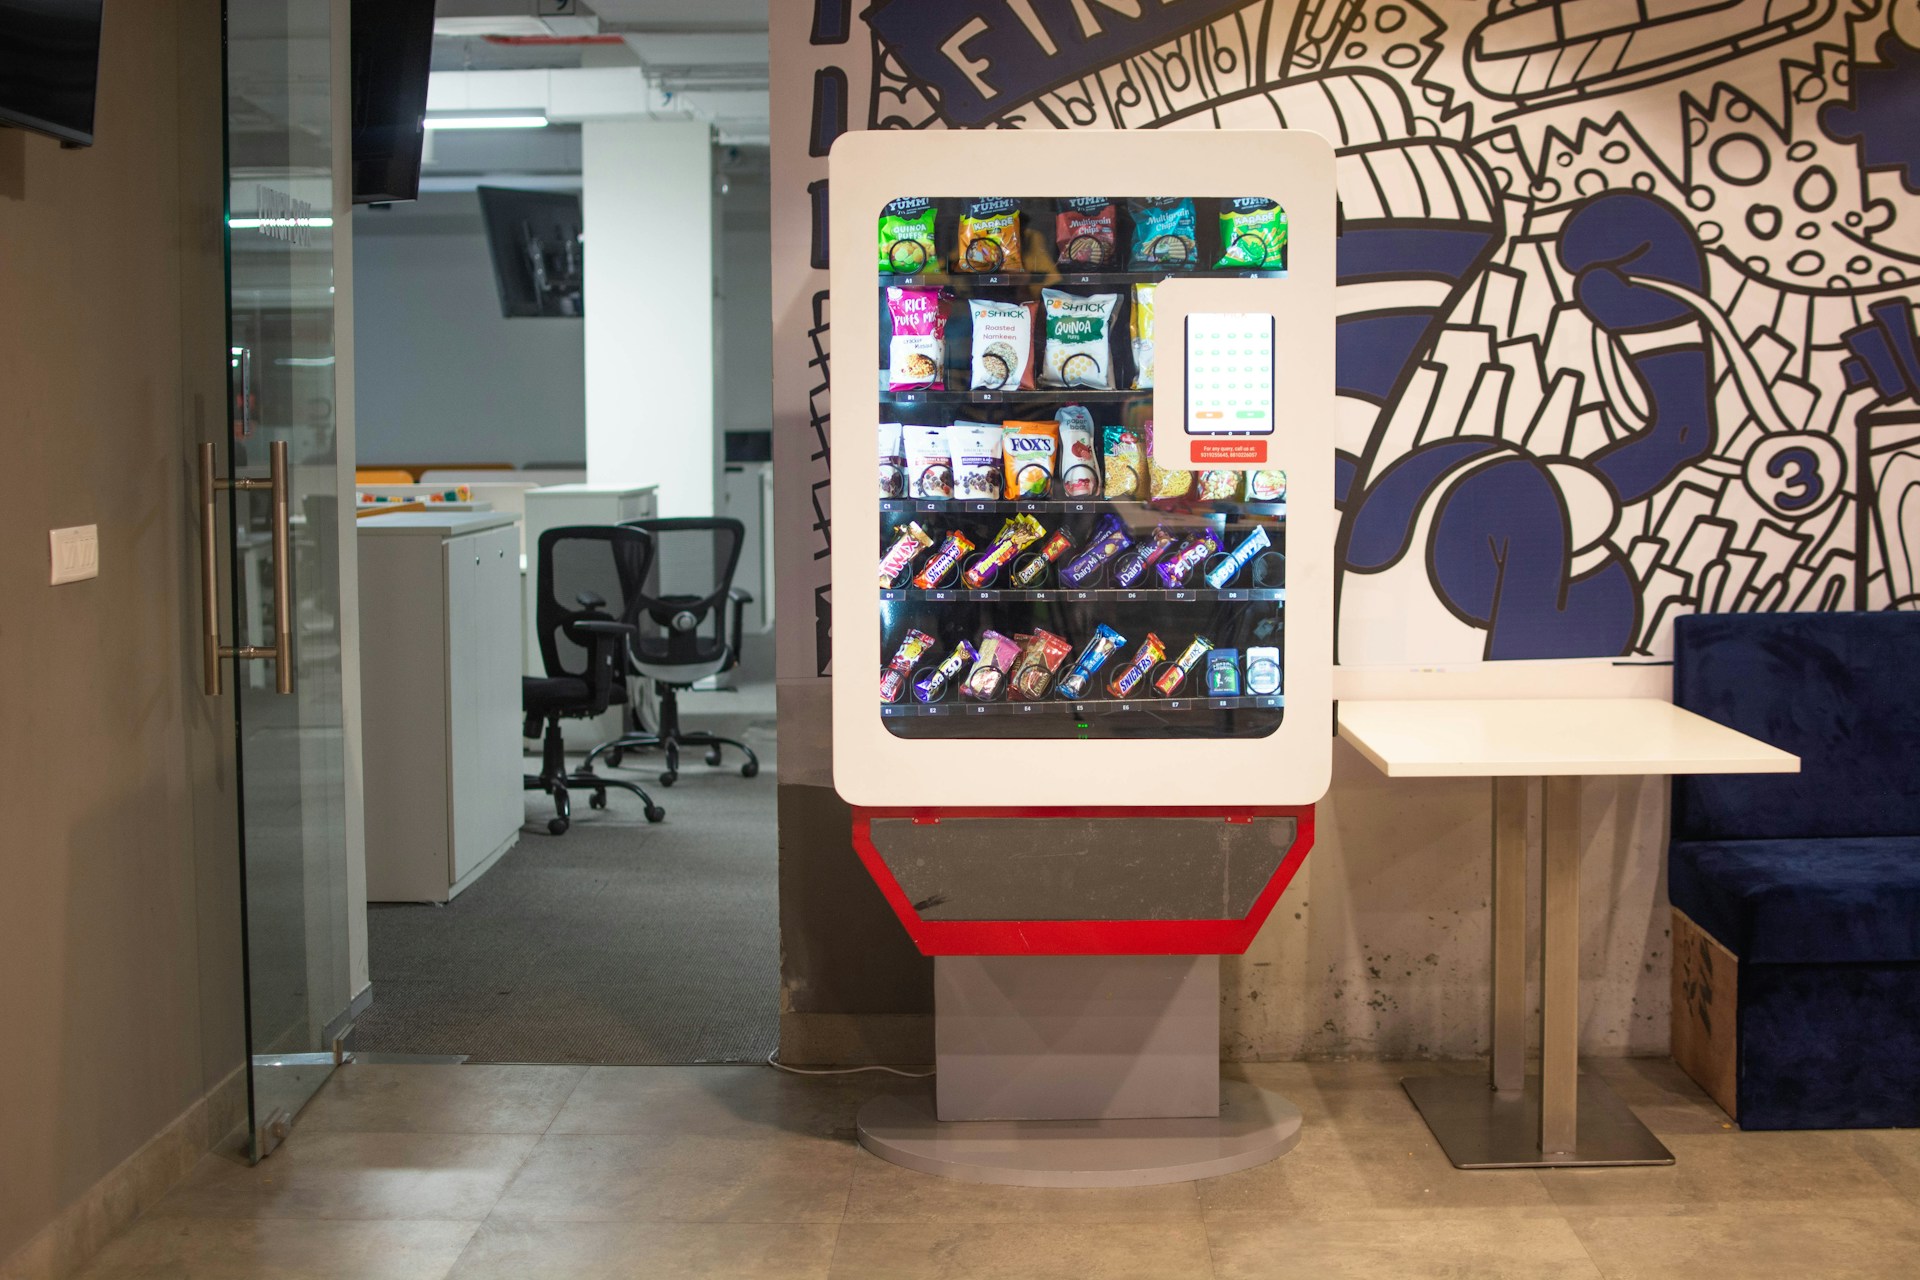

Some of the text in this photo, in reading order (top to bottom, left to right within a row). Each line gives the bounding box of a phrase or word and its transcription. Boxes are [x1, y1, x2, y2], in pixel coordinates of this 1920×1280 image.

[972, 199, 1014, 212] YUMM!
[973, 216, 1014, 231] KARARE
[1146, 208, 1190, 225] Multigrain
[893, 224, 926, 234] QUINOA
[1156, 220, 1177, 232] Chips
[904, 296, 927, 313] RICE
[1766, 446, 1824, 510] 3
[1073, 564, 1090, 581] Dairy
[1120, 562, 1142, 582] Dairy
